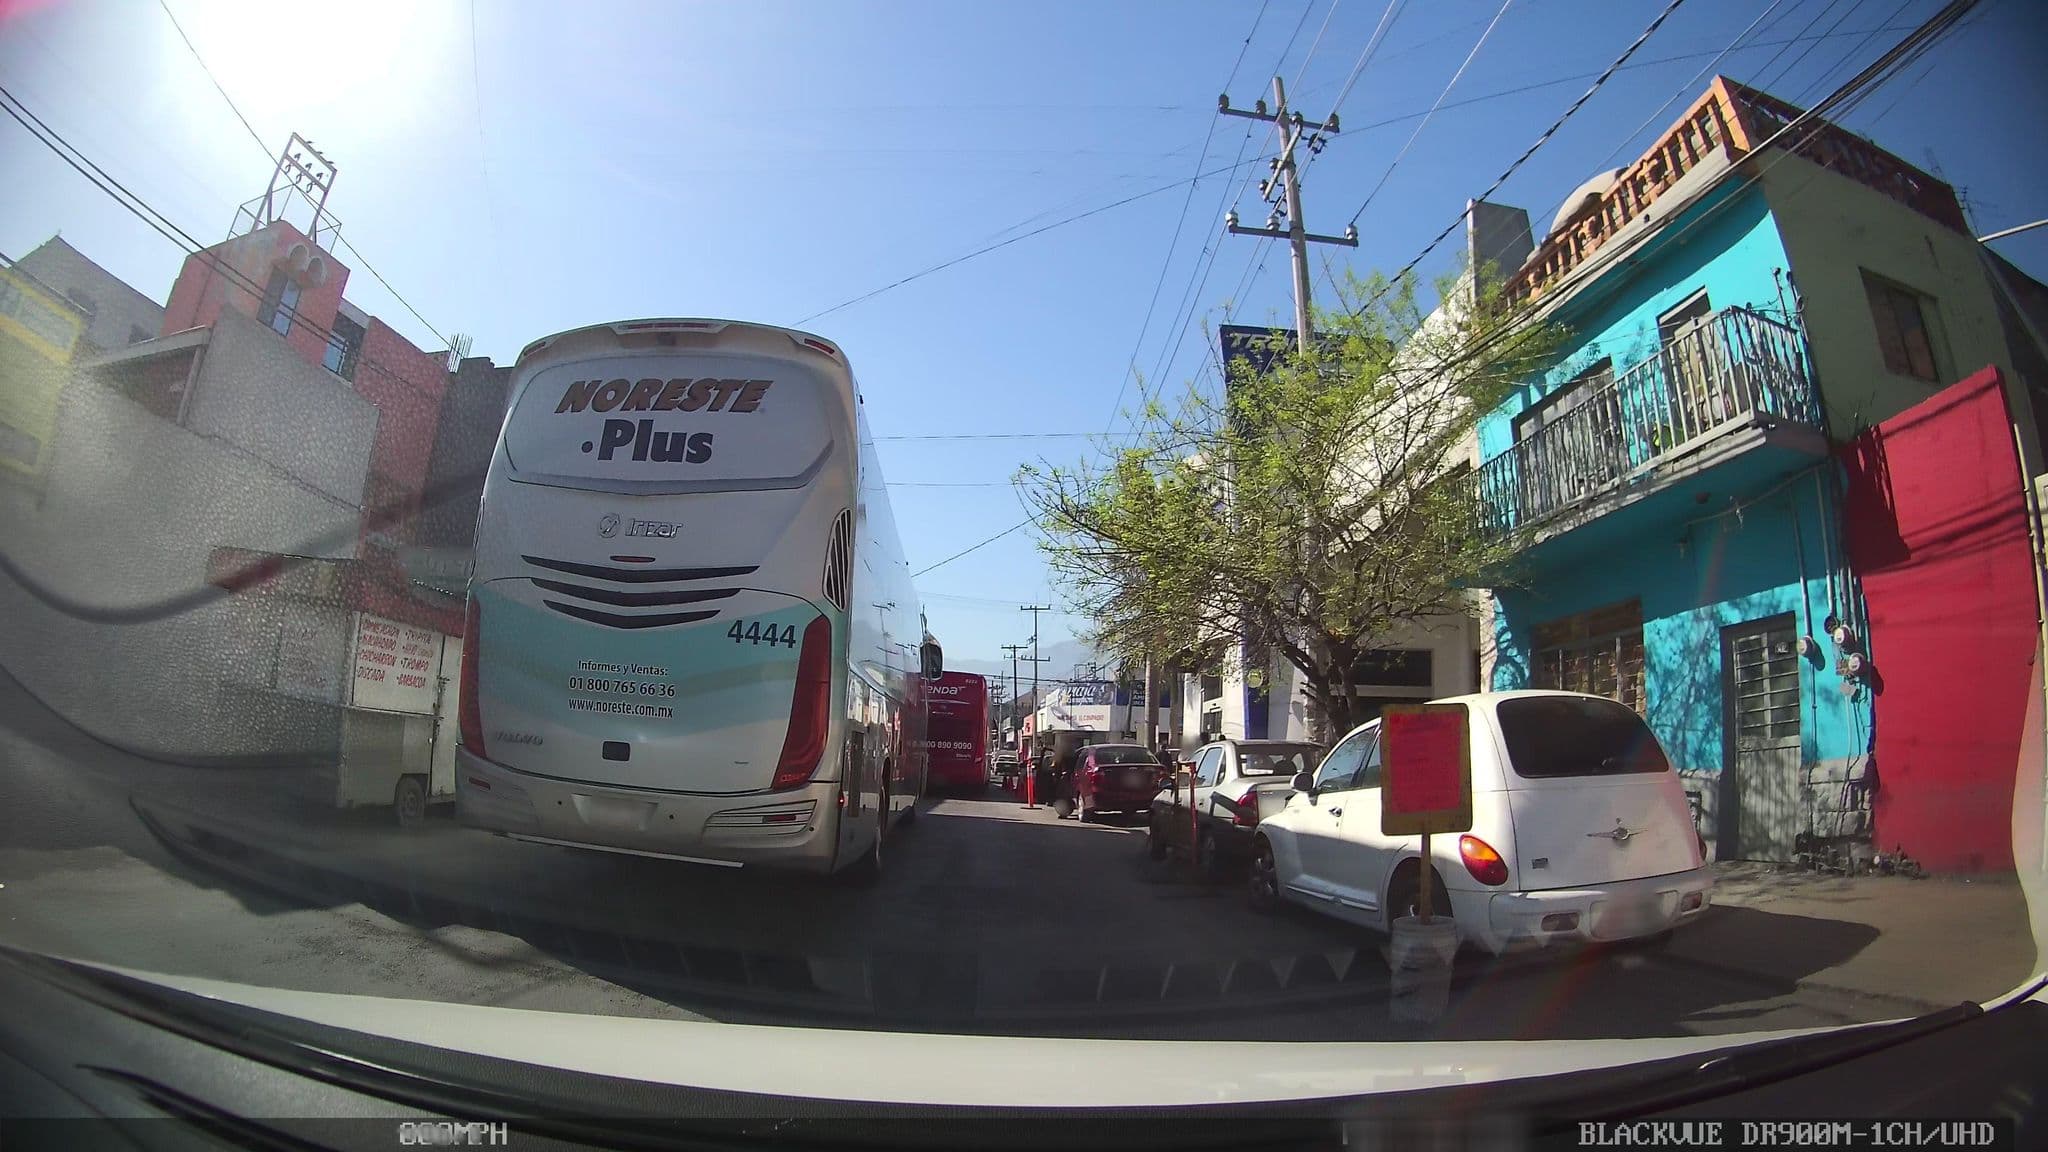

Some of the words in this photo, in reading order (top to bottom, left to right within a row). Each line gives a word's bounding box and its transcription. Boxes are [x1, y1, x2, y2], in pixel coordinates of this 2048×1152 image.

[554, 378, 773, 414] NORESTE
[727, 619, 796, 648] 4444
[578, 660, 620, 673] Informes
[622, 666, 629, 675] y
[631, 664, 668, 676] Ventas:
[569, 677, 583, 690] 01
[587, 678, 610, 693] 800
[613, 680, 636, 694] 765
[639, 682, 656, 696] 66
[658, 684, 675, 697] 36
[568, 698, 674, 719] www.noreste.com.mx
